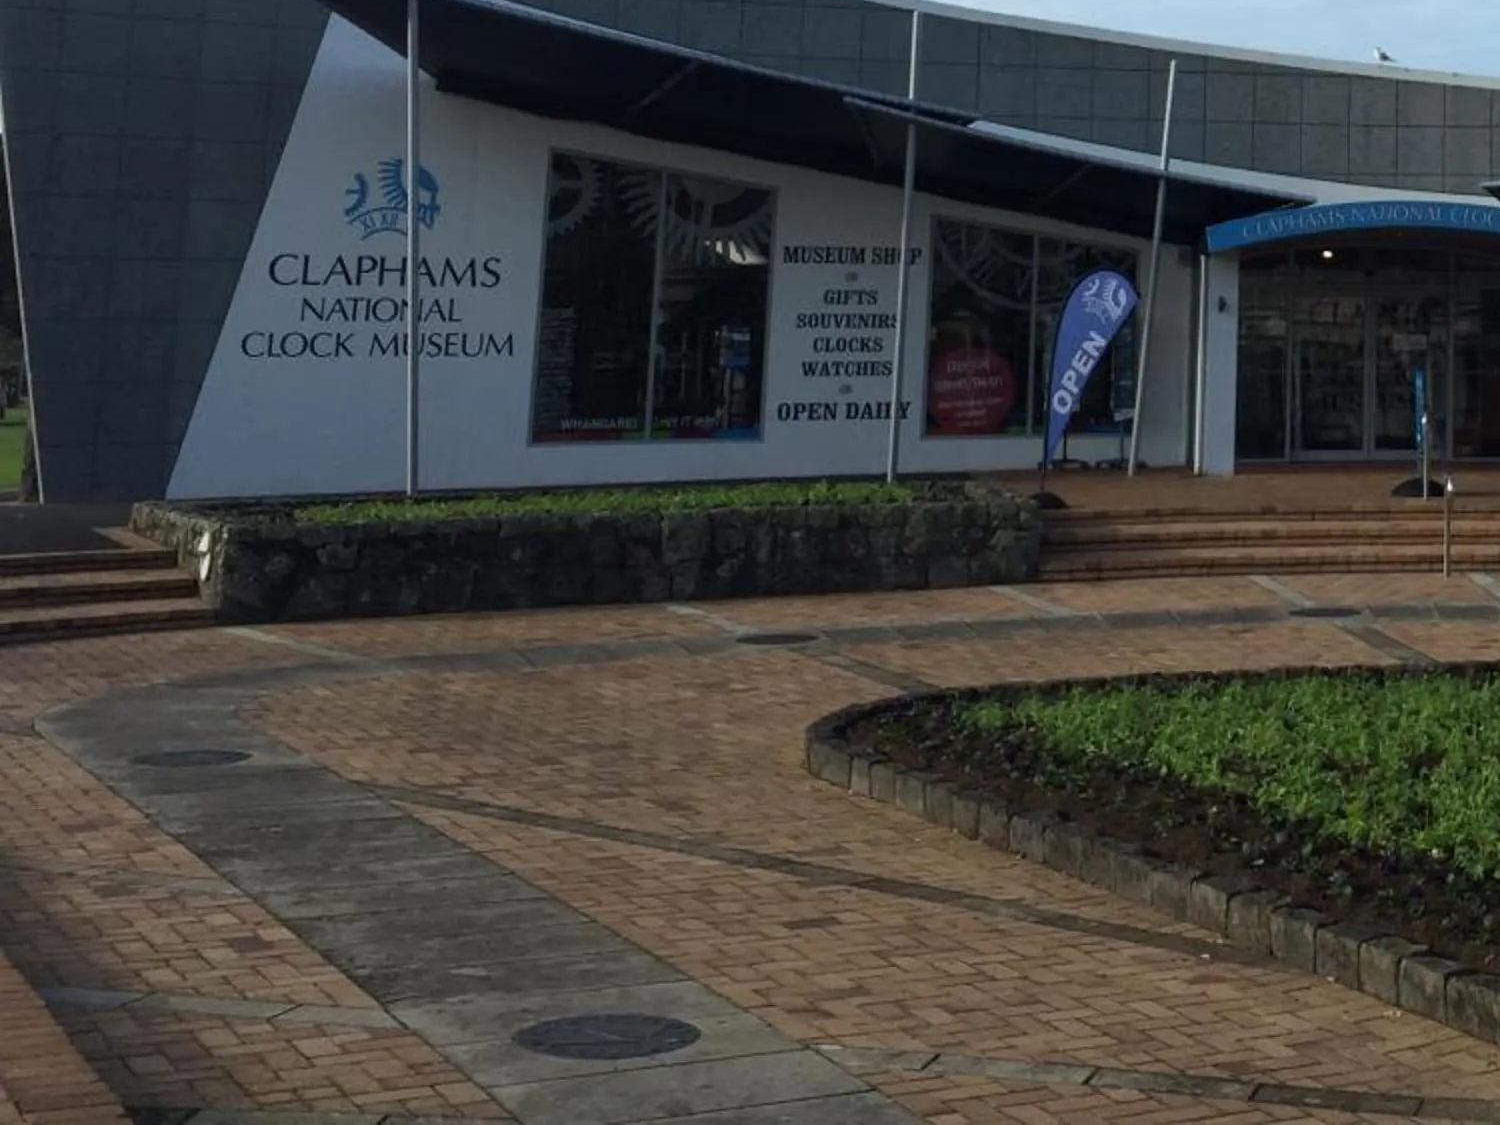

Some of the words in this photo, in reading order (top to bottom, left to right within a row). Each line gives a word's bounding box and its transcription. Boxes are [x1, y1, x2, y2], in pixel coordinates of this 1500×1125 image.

[1351, 205, 1442, 222] NATIONAL
[783, 246, 866, 265] MUSEUM
[871, 246, 923, 266] SHP
[268, 253, 502, 288] CLAPHAMS
[823, 289, 879, 306] GIFTS
[300, 297, 463, 323] NATIONAL
[240, 331, 355, 358] CLOCK
[368, 332, 515, 358] MUSEUM
[813, 337, 884, 353] CLOCKS
[802, 361, 893, 377] WATCHES
[1052, 331, 1108, 414] OPEN
[777, 402, 838, 422] OPEN
